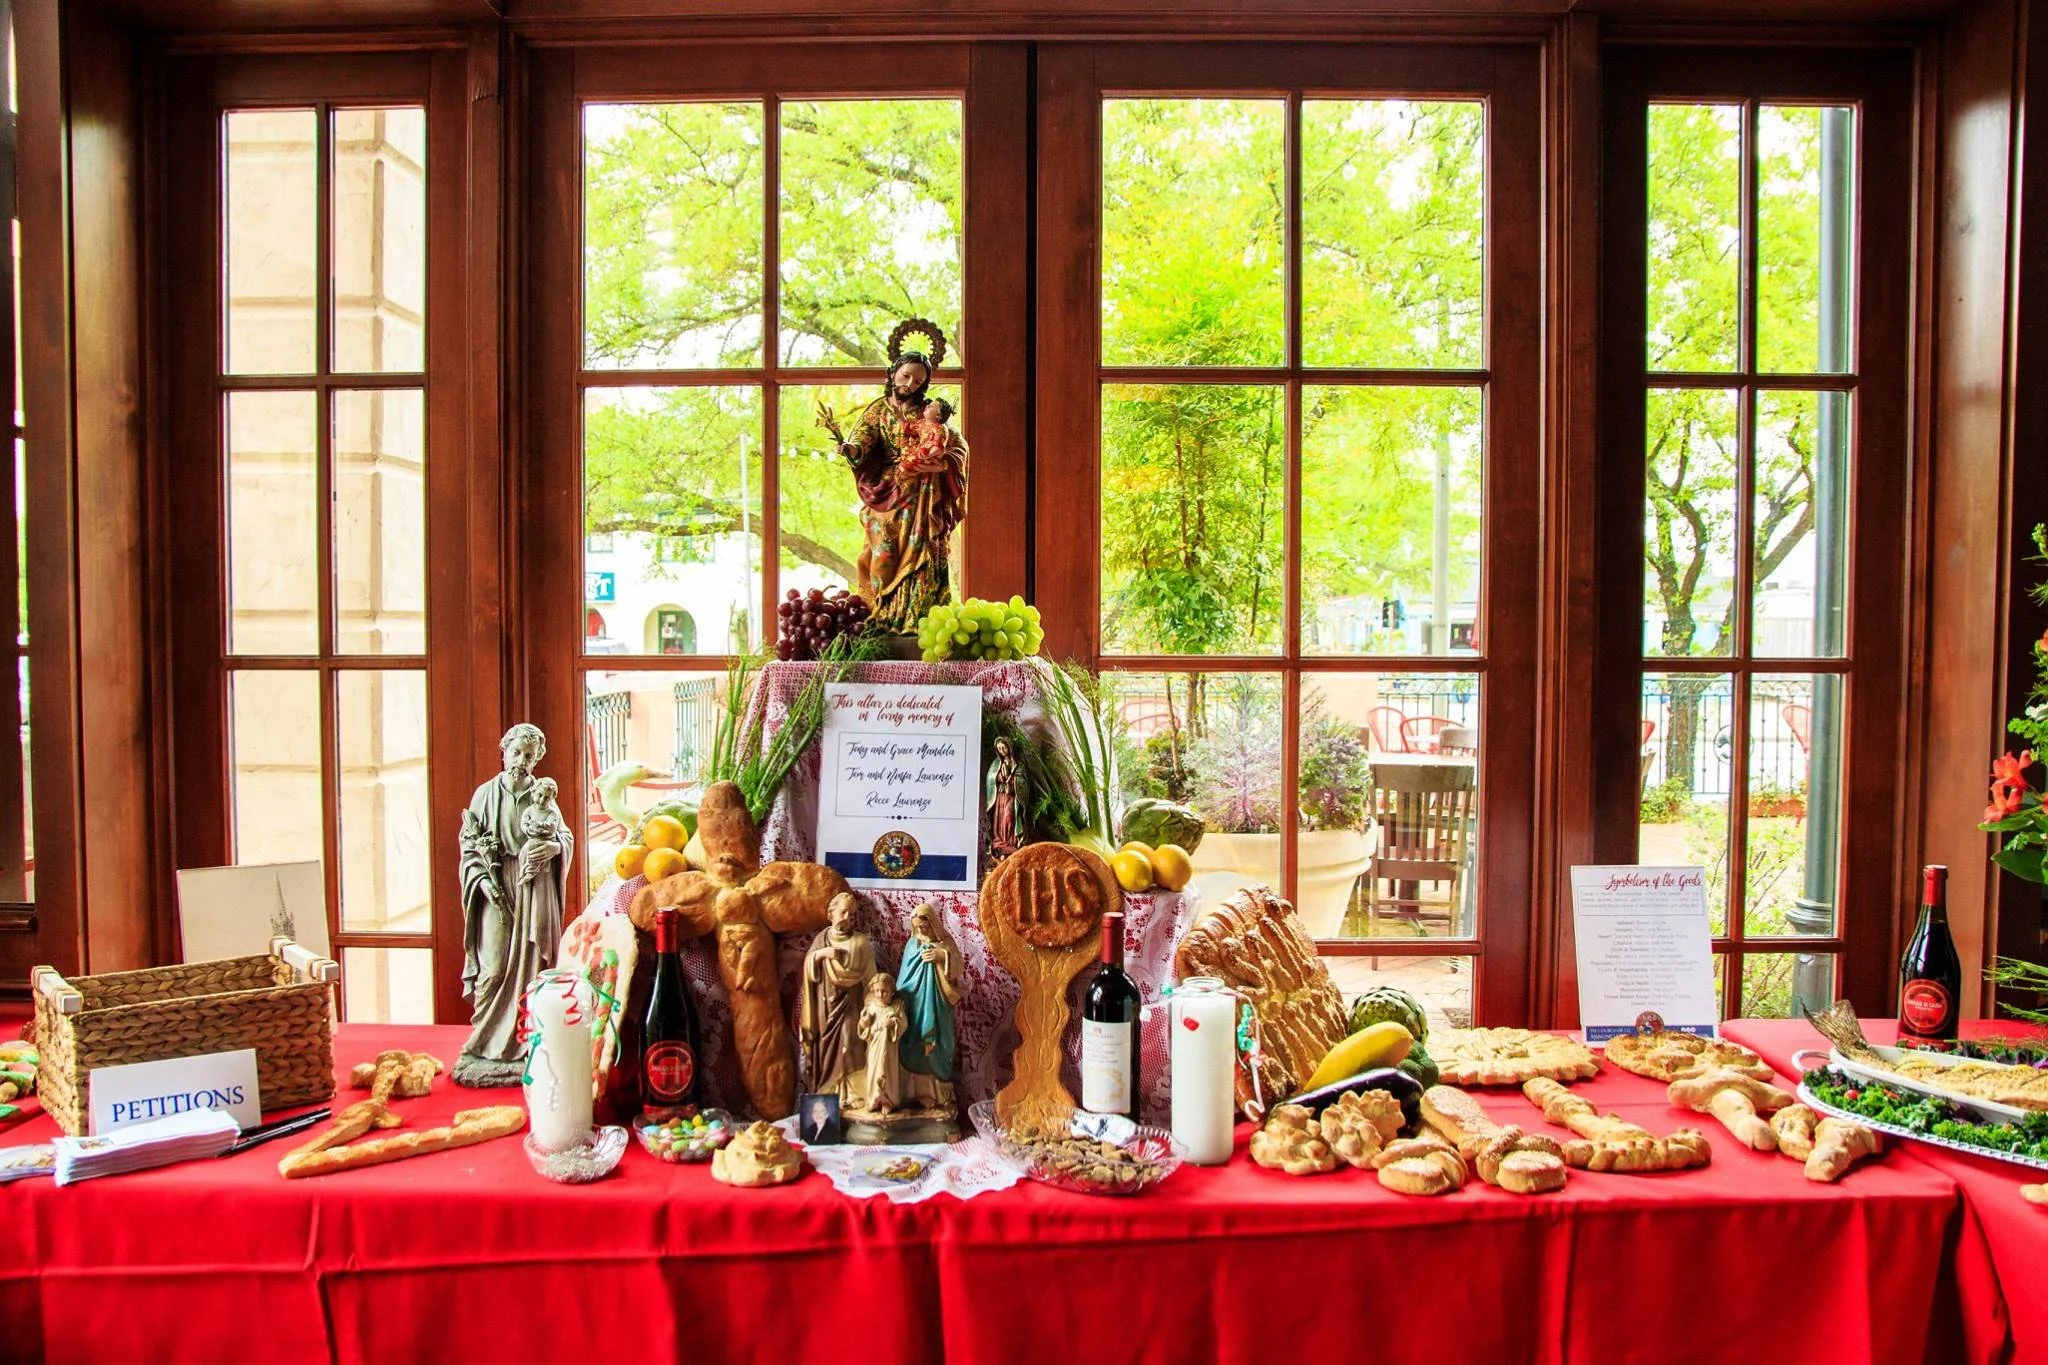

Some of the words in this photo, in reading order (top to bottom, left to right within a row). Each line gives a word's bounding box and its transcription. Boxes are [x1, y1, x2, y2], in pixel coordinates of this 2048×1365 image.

[832, 693, 854, 710] This
[857, 693, 882, 709] altar
[885, 697, 893, 709] is
[896, 694, 945, 710] dedicated
[858, 711, 869, 722] in
[876, 706, 904, 727] loving
[907, 712, 943, 729] memory
[945, 712, 954, 727] of
[870, 741, 889, 755] and
[890, 742, 913, 760] Grace
[867, 766, 886, 780] and
[1606, 872, 1649, 890] Symbolism
[1652, 875, 1661, 890] of
[1662, 871, 1675, 886] the
[112, 1085, 246, 1123] PETITIONS
